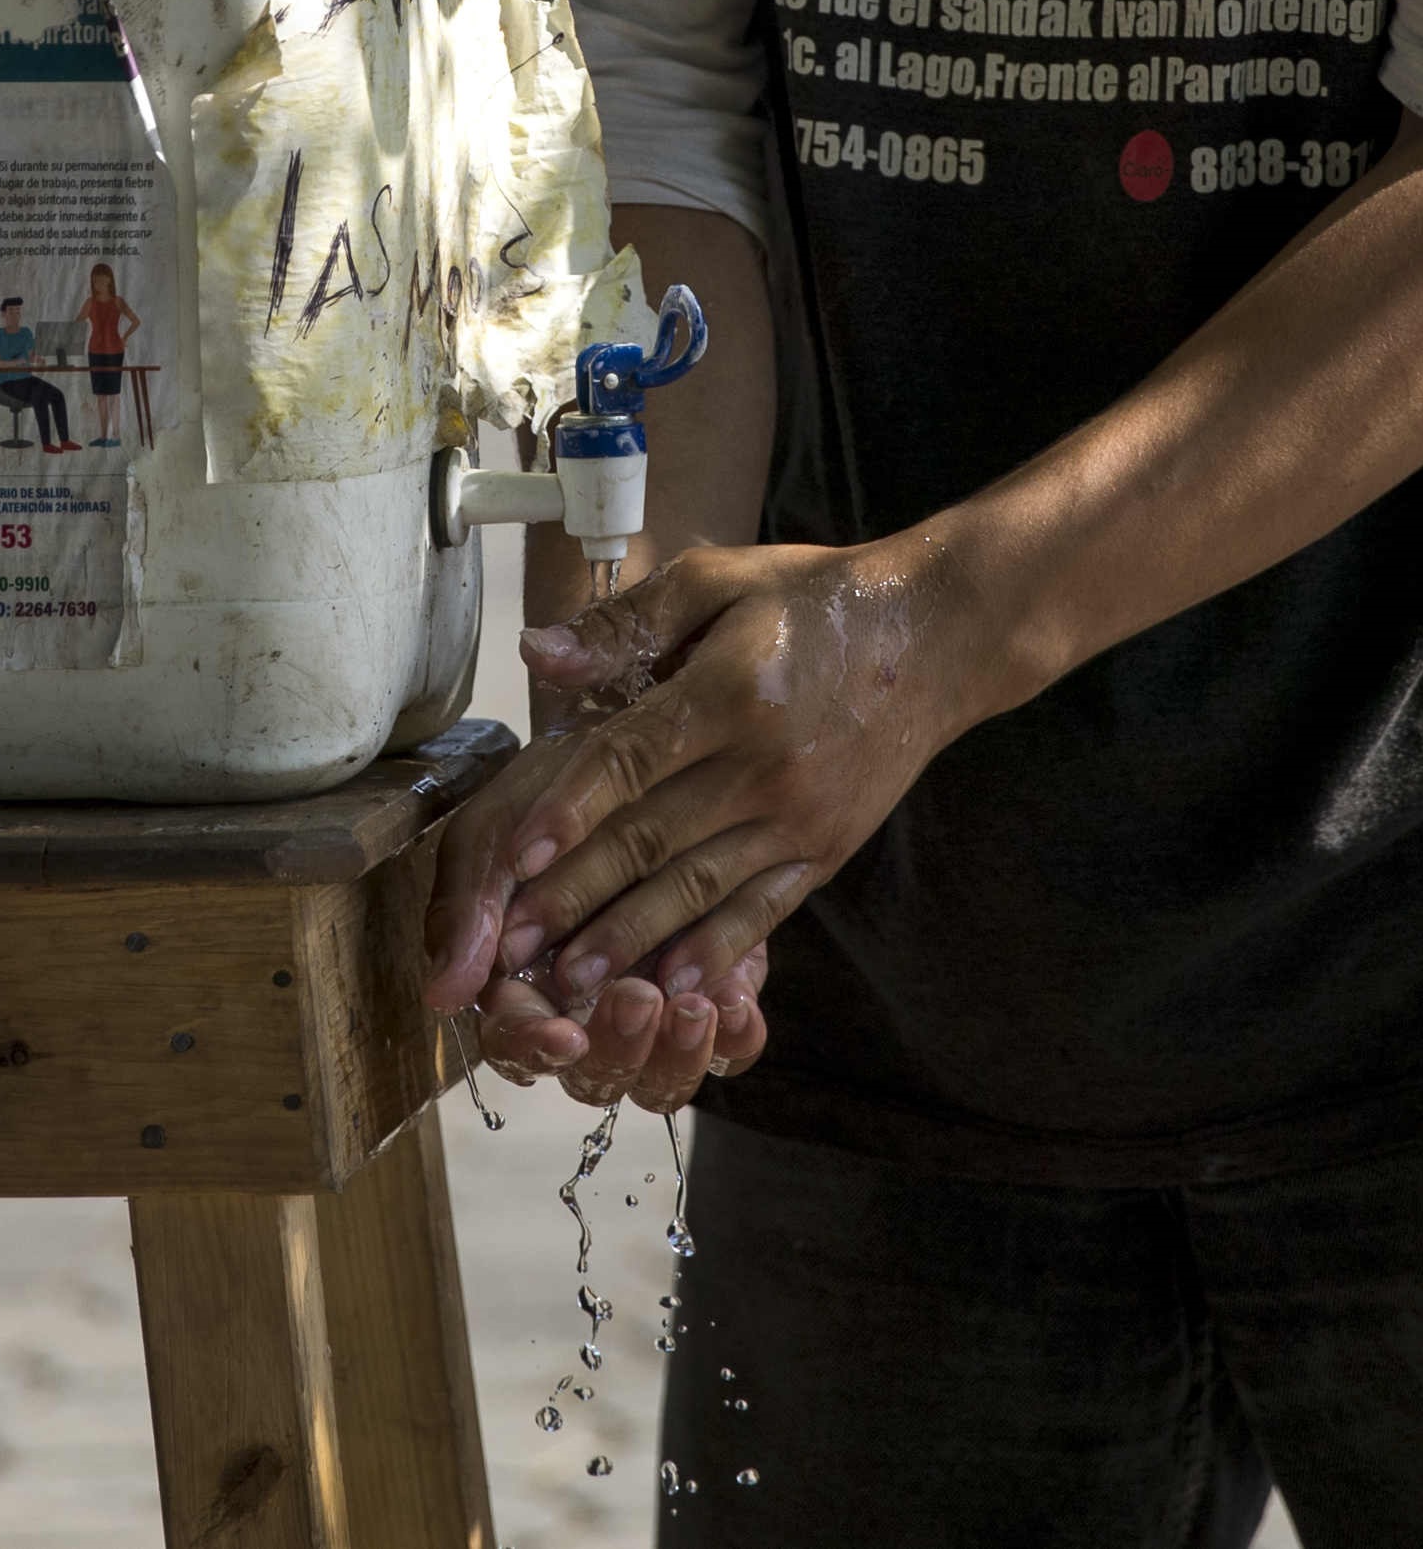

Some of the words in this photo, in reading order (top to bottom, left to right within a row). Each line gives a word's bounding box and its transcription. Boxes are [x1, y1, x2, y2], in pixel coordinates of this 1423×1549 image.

[835, 37, 871, 83] al
[1127, 56, 1160, 102] al
[1165, 56, 1329, 104] Parqueo.
[10, 161, 48, 172] durante
[51, 163, 63, 172] su
[65, 161, 128, 175] permanencia
[130, 163, 143, 172] en
[145, 161, 155, 172] el
[0, 178, 25, 192] lugar
[26, 178, 39, 189] de
[80, 179, 123, 191] presenta
[124, 178, 154, 189] fiebre
[38, 194, 77, 205] síntoma
[0, 211, 24, 222] debe
[0, 228, 9, 239] la
[10, 228, 44, 239] unidad
[46, 228, 59, 239] de
[61, 228, 88, 239] salud
[20, 487, 34, 499] DE
[55, 501, 68, 513] 24
[14, 601, 97, 618] 2264-7630
